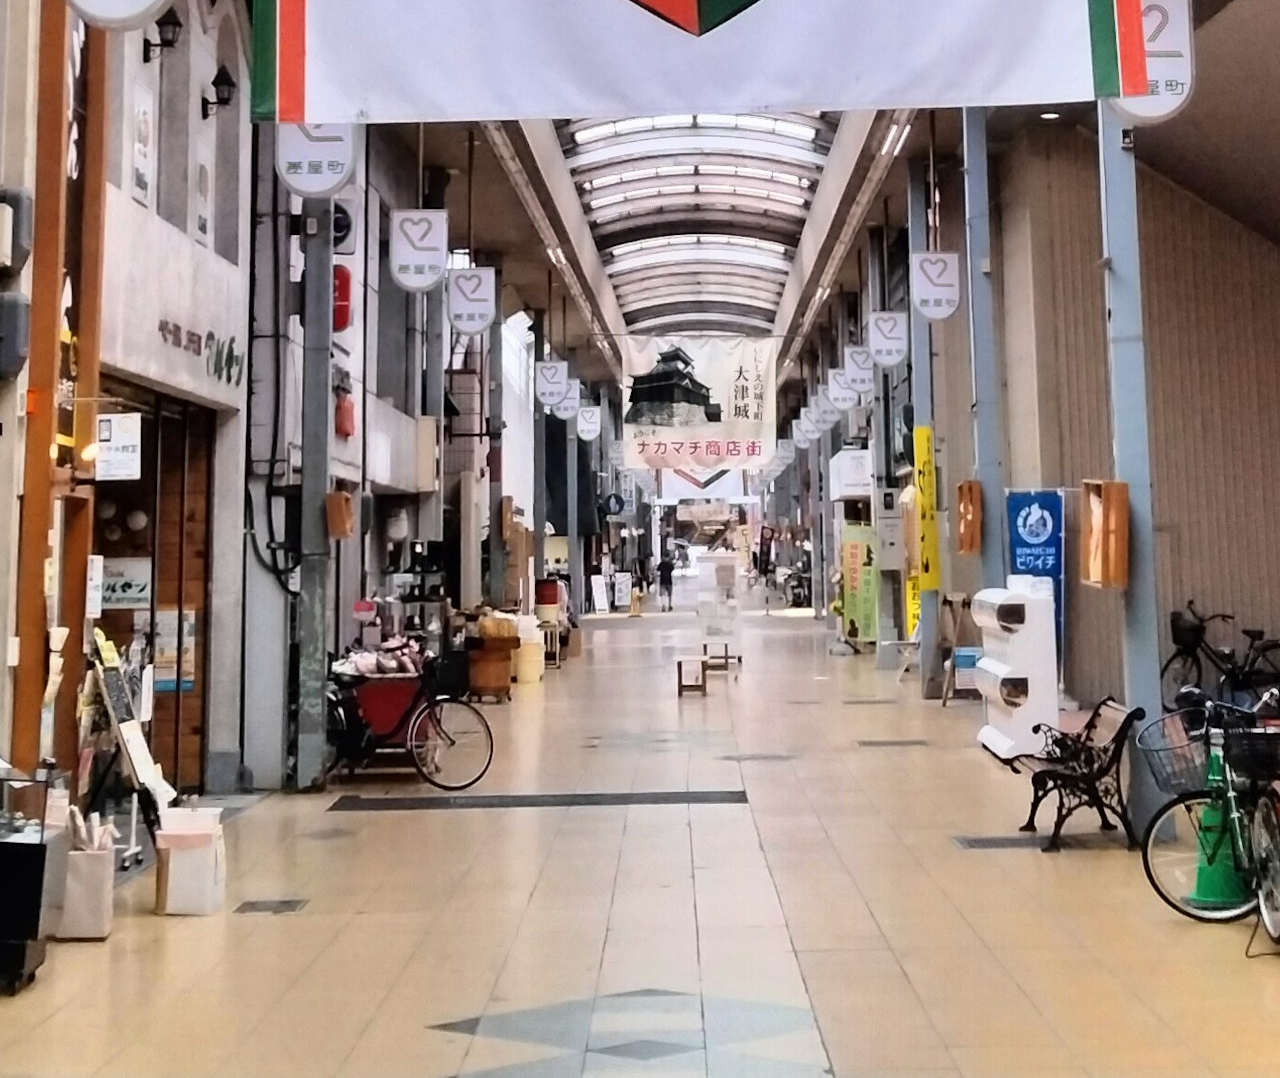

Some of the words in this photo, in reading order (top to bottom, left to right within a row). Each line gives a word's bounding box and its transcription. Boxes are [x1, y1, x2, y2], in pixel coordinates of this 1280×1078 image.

[1148, 79, 1186, 96] 屋町
[733, 365, 750, 420] 大津城
[637, 440, 762, 457] ナカマチ商店街
[1016, 555, 1056, 570] ビワイチ
